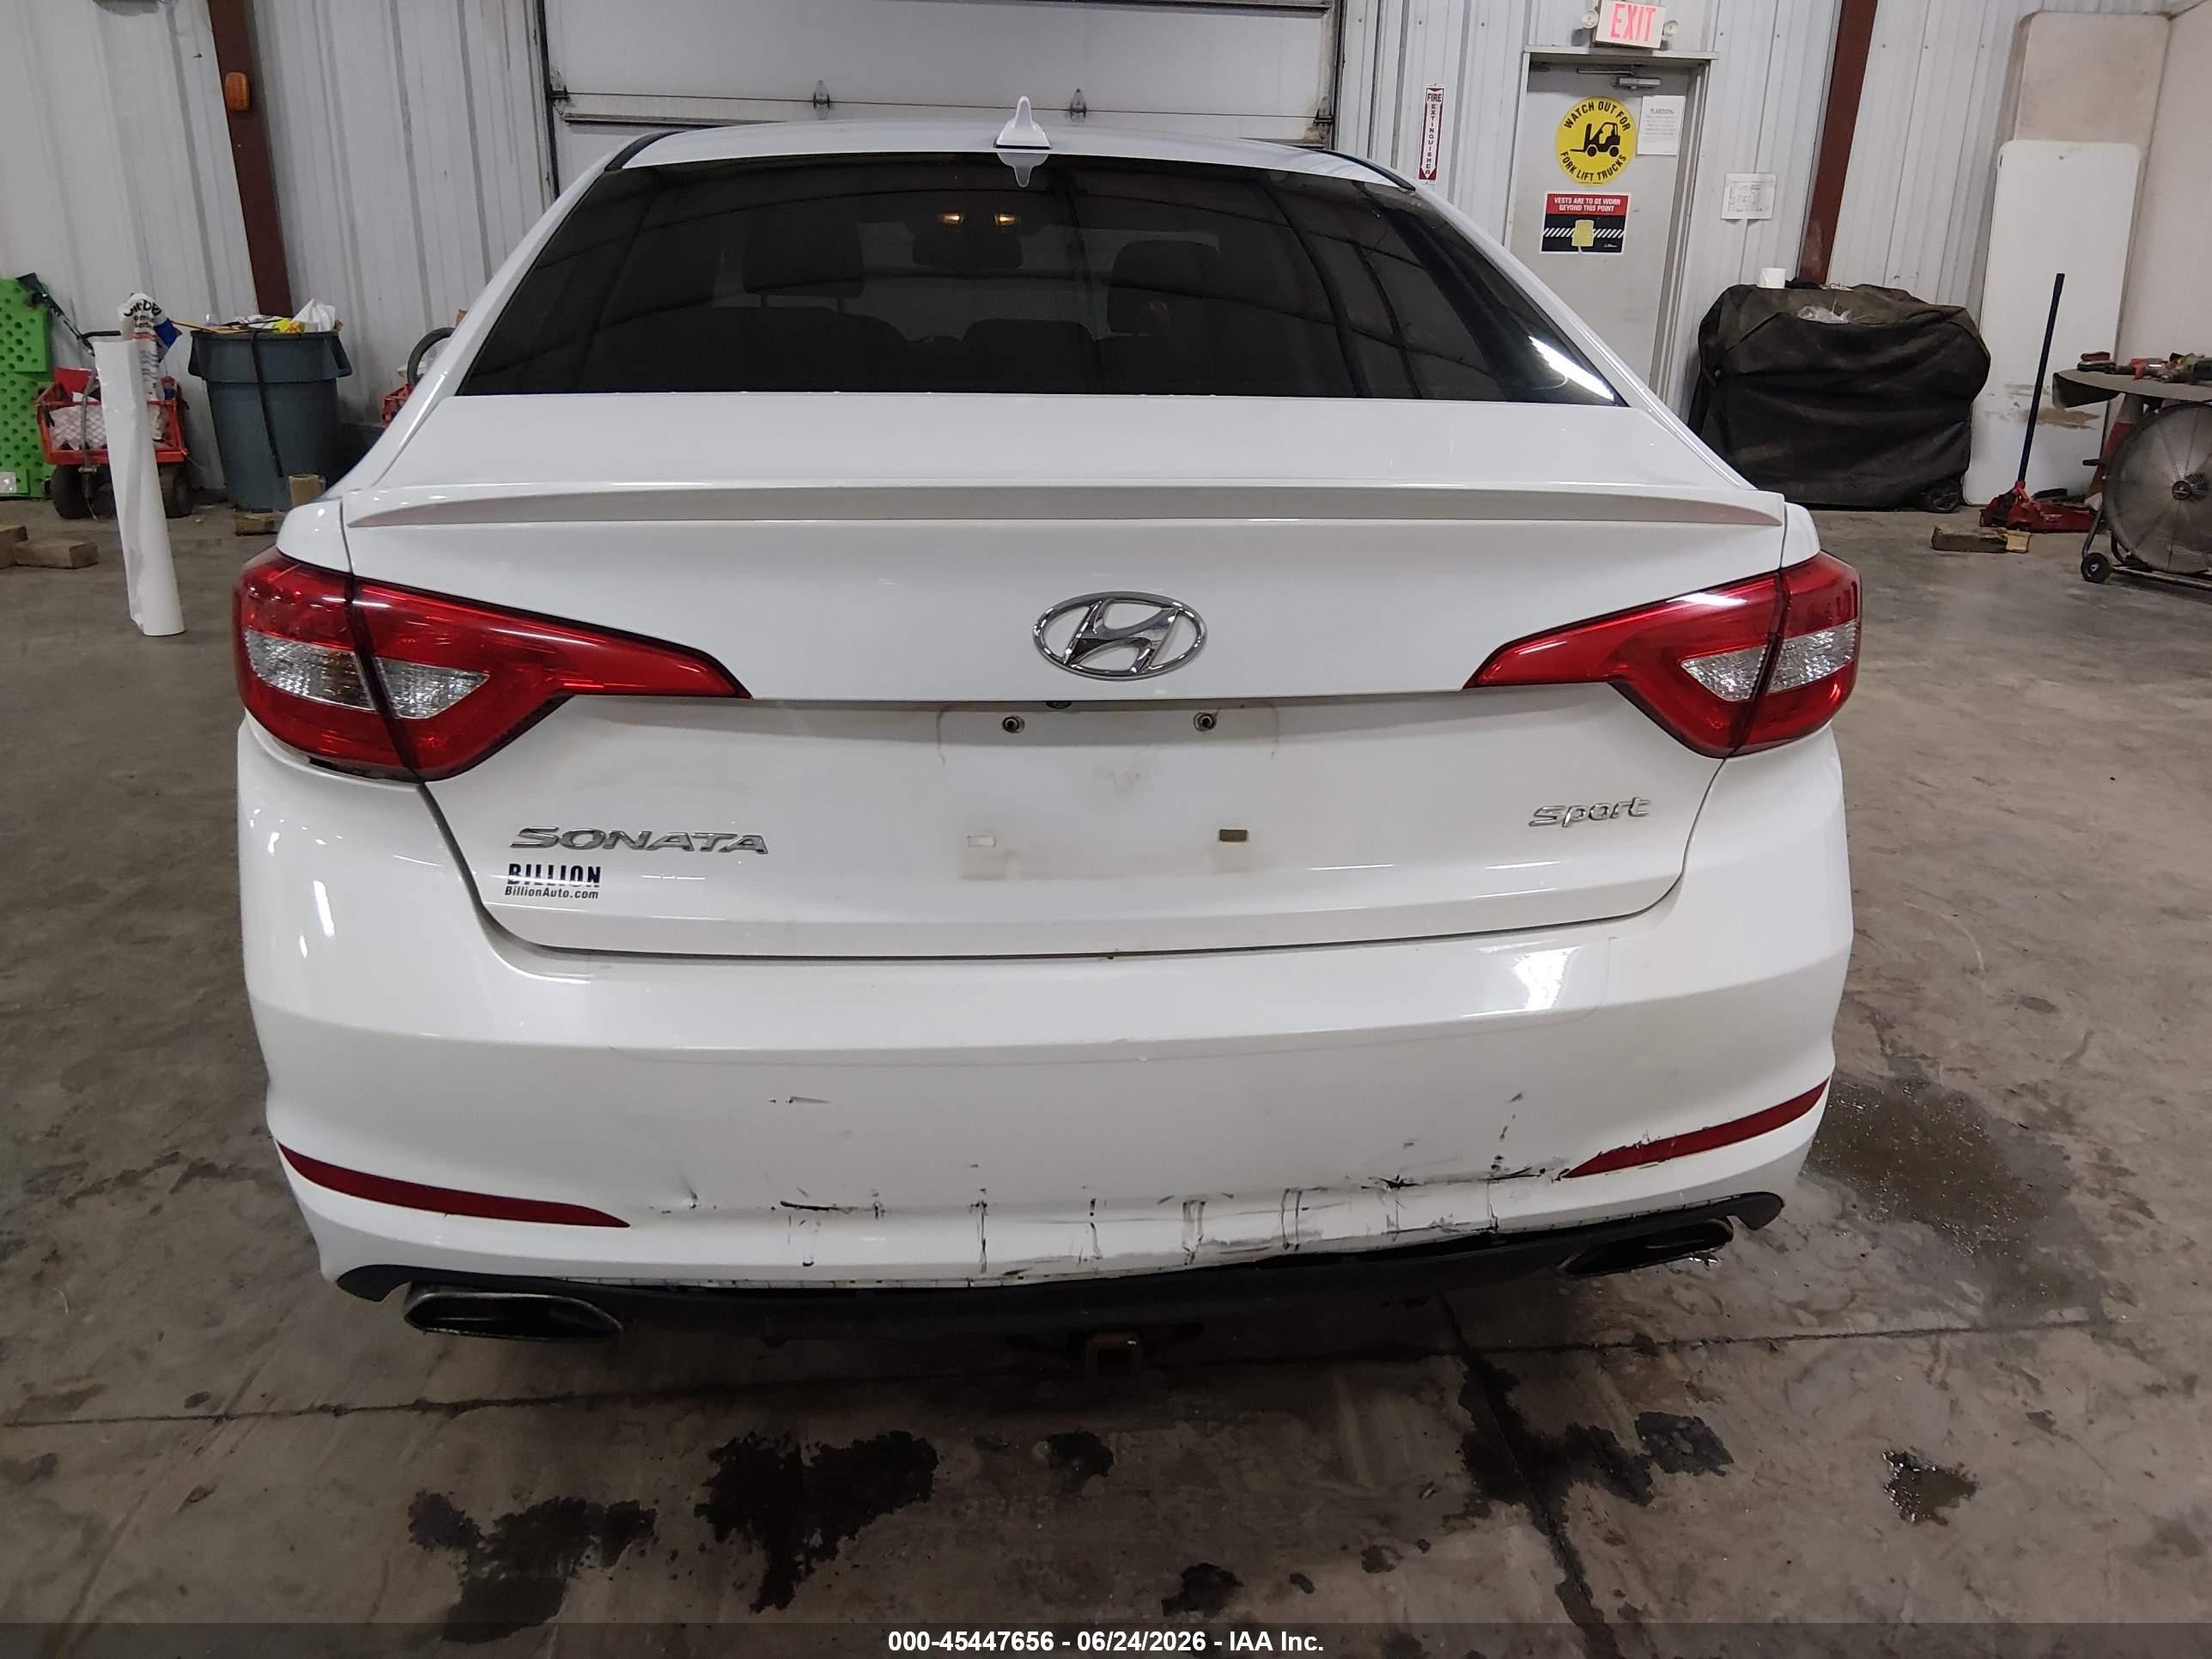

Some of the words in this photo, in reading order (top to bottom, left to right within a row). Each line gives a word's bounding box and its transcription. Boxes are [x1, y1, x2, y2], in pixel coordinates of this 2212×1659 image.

[1610, 3, 1656, 42] EXIT
[1426, 93, 1443, 102] FIRE
[1564, 101, 1595, 129] WATCH
[1597, 100, 1617, 113] OUT
[1615, 110, 1631, 131] FOR
[1425, 103, 1437, 175] EXTINGUISHER
[1560, 151, 1576, 174] FORK
[1576, 169, 1595, 182] LIFT
[1597, 154, 1627, 181] TRUCKS
[1528, 797, 1651, 828] Sport
[509, 826, 769, 854] SONATA
[507, 863, 601, 887] BILLION
[504, 886, 599, 899] BillionAuto.com
